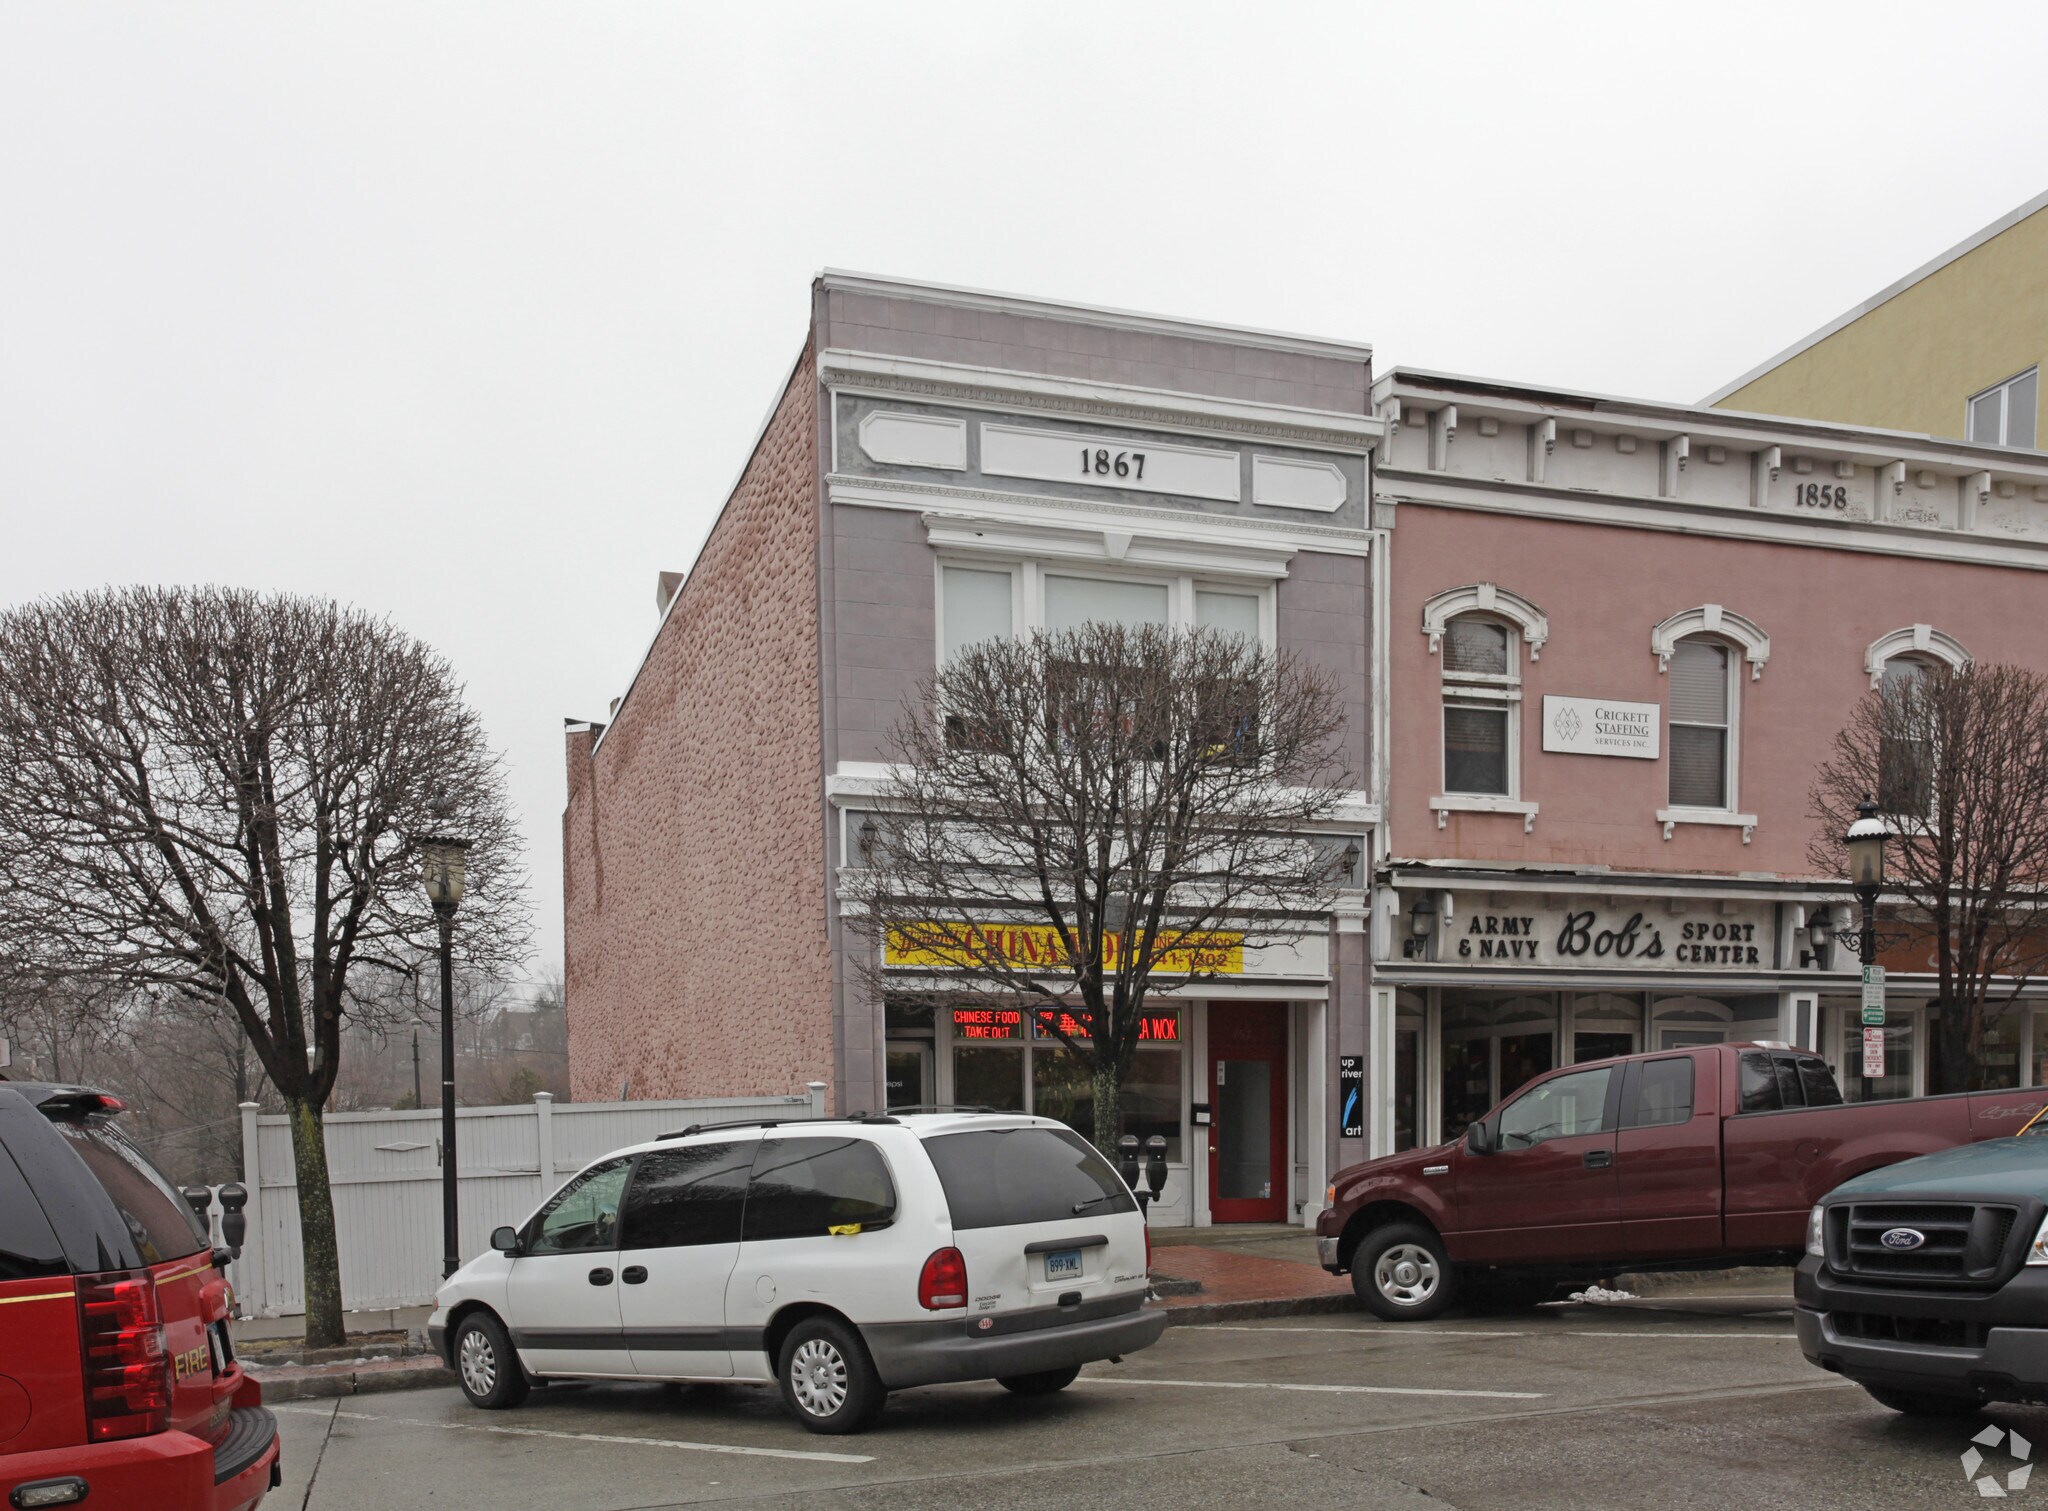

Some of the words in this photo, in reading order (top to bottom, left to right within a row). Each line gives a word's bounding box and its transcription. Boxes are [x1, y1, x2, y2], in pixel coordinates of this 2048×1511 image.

[1082, 448, 1145, 479] 1867
[1796, 483, 1847, 509] 1858
[1595, 707, 1650, 723] CRICKETT
[1595, 722, 1649, 736] STAFFING
[1595, 738, 1631, 747] SERVICES
[1633, 740, 1649, 748] INC.
[1469, 916, 1534, 935] ARMY
[1682, 922, 1755, 942] SPORT
[1557, 911, 1665, 958] Bob's
[964, 929, 1058, 964] CHINA
[1458, 939, 1471, 957] &
[1480, 939, 1539, 958] NAVY
[1676, 944, 1759, 964] CENTER
[1149, 952, 1228, 967] 41-1202
[1864, 969, 1870, 982] 2
[954, 1011, 993, 1024] CHINESE
[995, 1011, 1020, 1024] FOOD
[965, 1026, 989, 1039] TAKE
[991, 1027, 1010, 1039] OUT
[1152, 1018, 1177, 1040] WOK
[1341, 1059, 1355, 1068] up
[1341, 1069, 1362, 1078] river
[887, 1080, 903, 1088] epsi
[1345, 1125, 1362, 1136] art
[174, 1345, 208, 1381] FIRE
